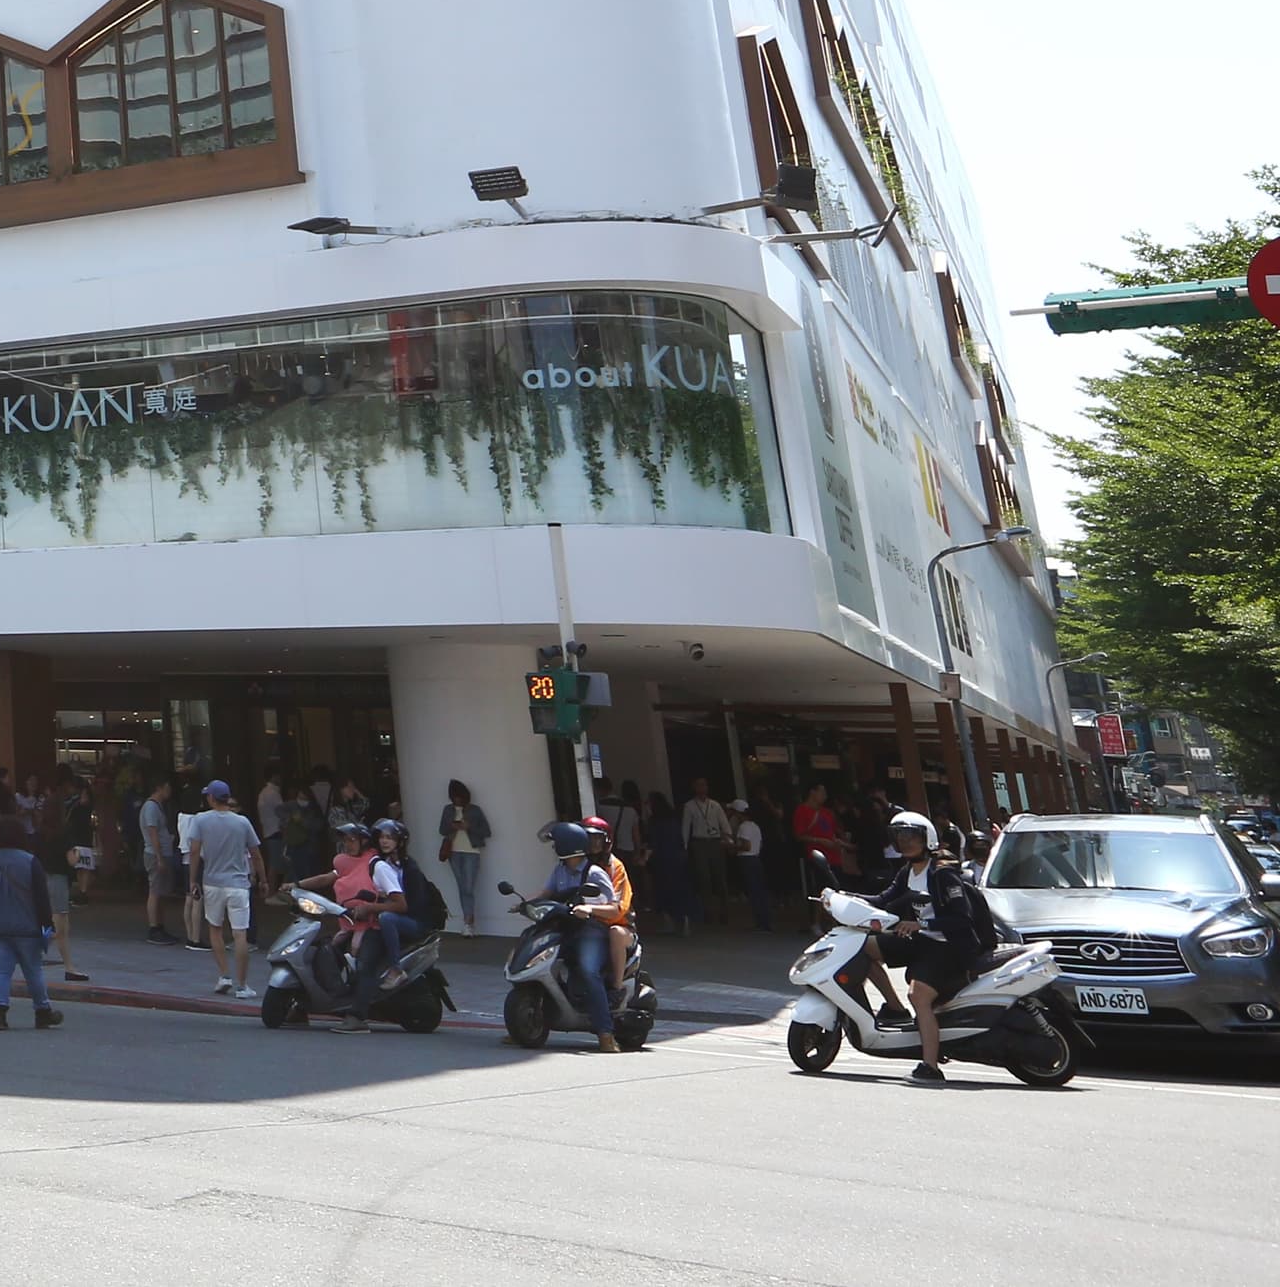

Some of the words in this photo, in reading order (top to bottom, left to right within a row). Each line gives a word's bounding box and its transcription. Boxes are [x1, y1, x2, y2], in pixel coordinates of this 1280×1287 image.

[522, 362, 633, 391] about
[3, 385, 134, 435] KUAN
[142, 386, 198, 415] 寬庭
[531, 676, 555, 699] 20
[1080, 992, 1146, 1010] AND-6878
